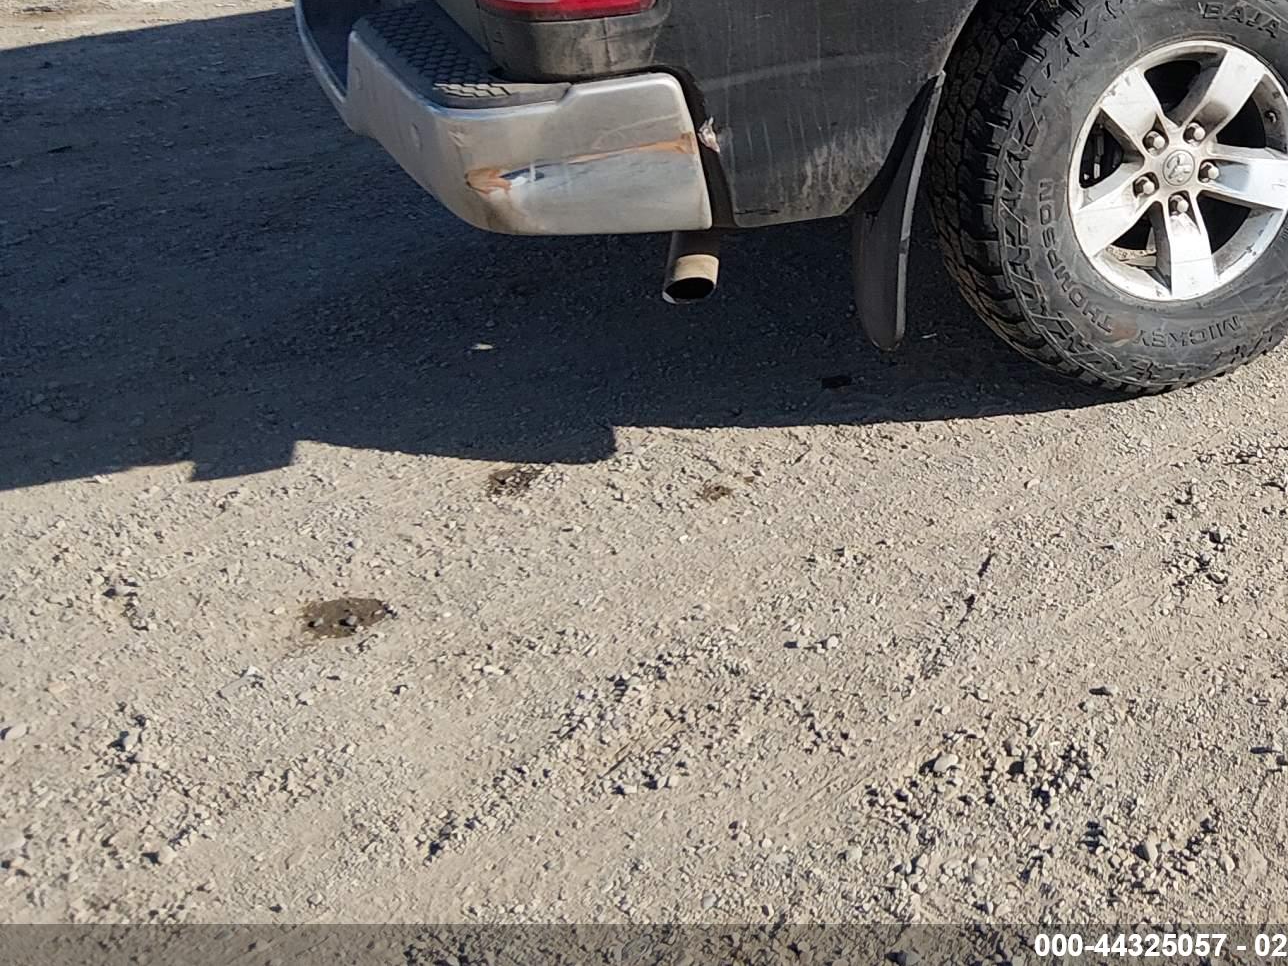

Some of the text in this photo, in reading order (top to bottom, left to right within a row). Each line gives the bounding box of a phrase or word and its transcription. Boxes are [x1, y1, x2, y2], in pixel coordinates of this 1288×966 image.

[1202, 1, 1280, 39] BAJA
[1038, 178, 1242, 348] MICKEY THOMPSON
